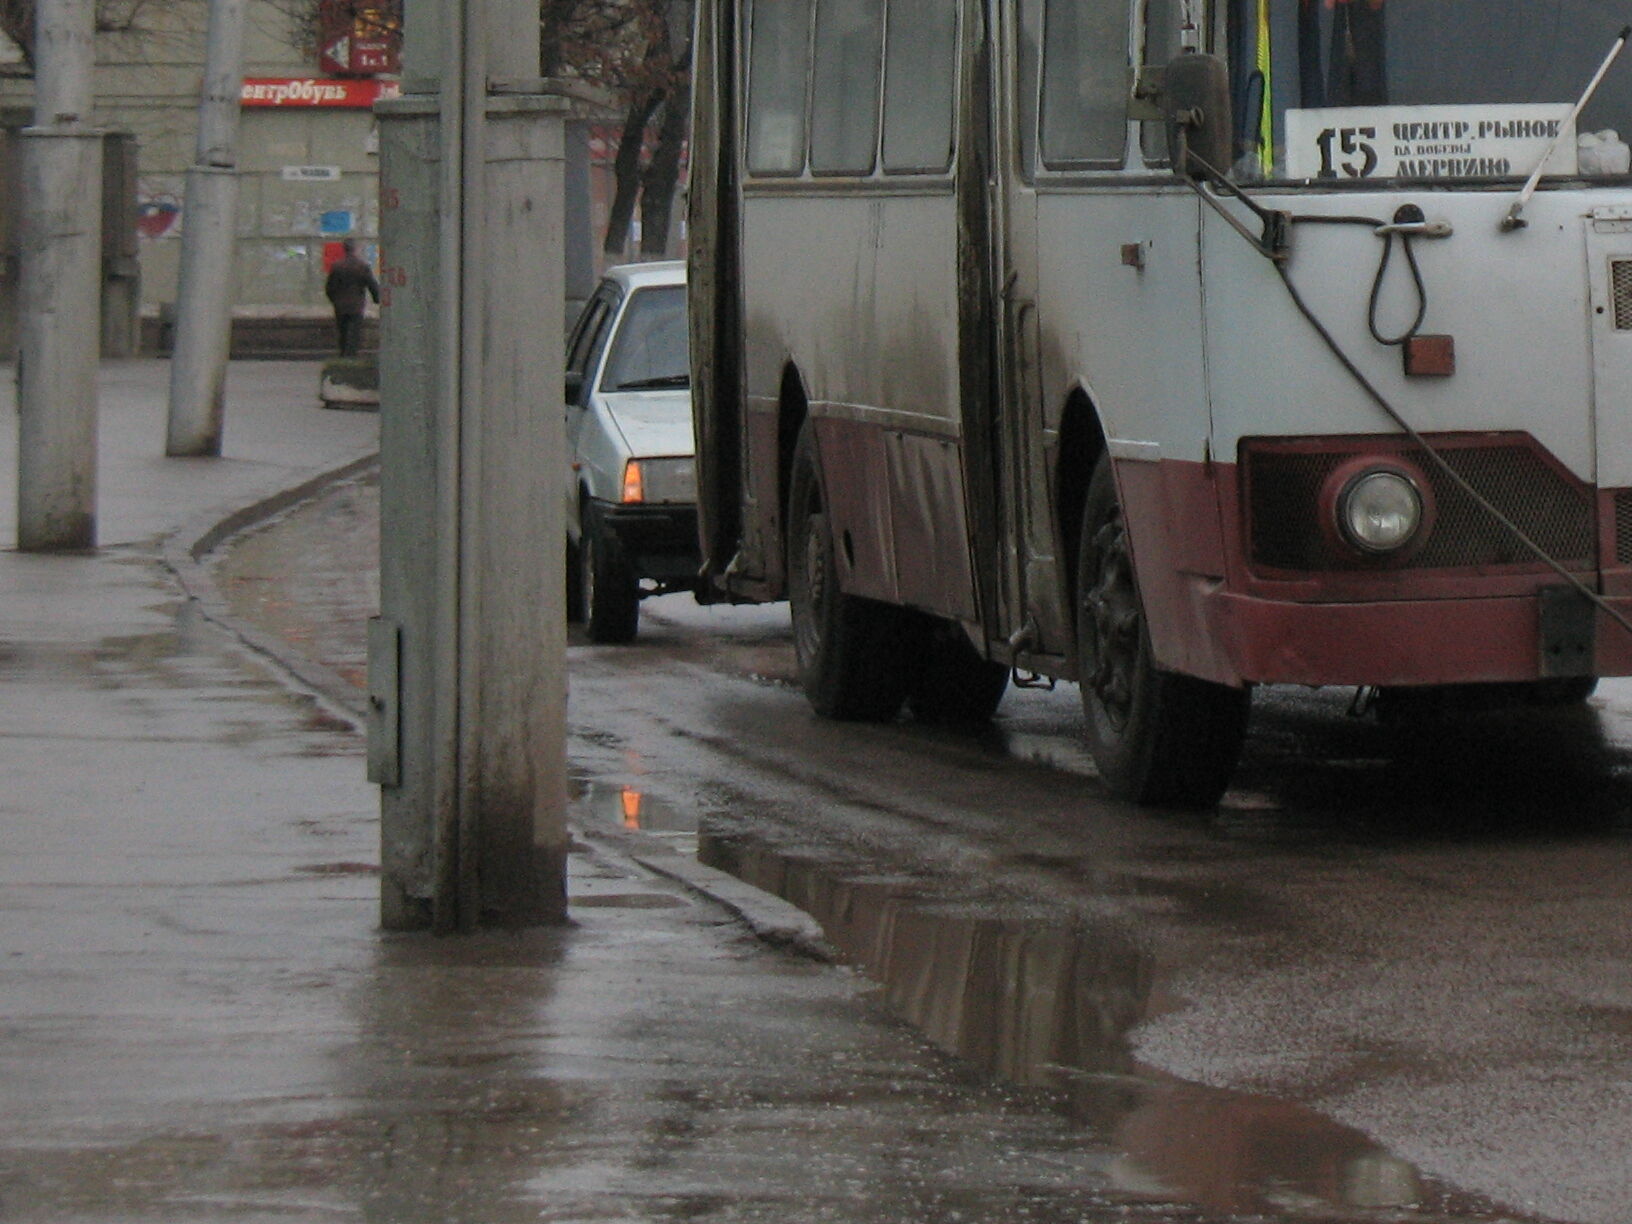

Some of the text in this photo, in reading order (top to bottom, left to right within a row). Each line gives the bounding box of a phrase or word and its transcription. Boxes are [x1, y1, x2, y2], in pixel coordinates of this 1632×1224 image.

[241, 79, 347, 104] ентрОбувь
[1478, 119, 1562, 139] РЫНОК
[1316, 126, 1378, 178] 15
